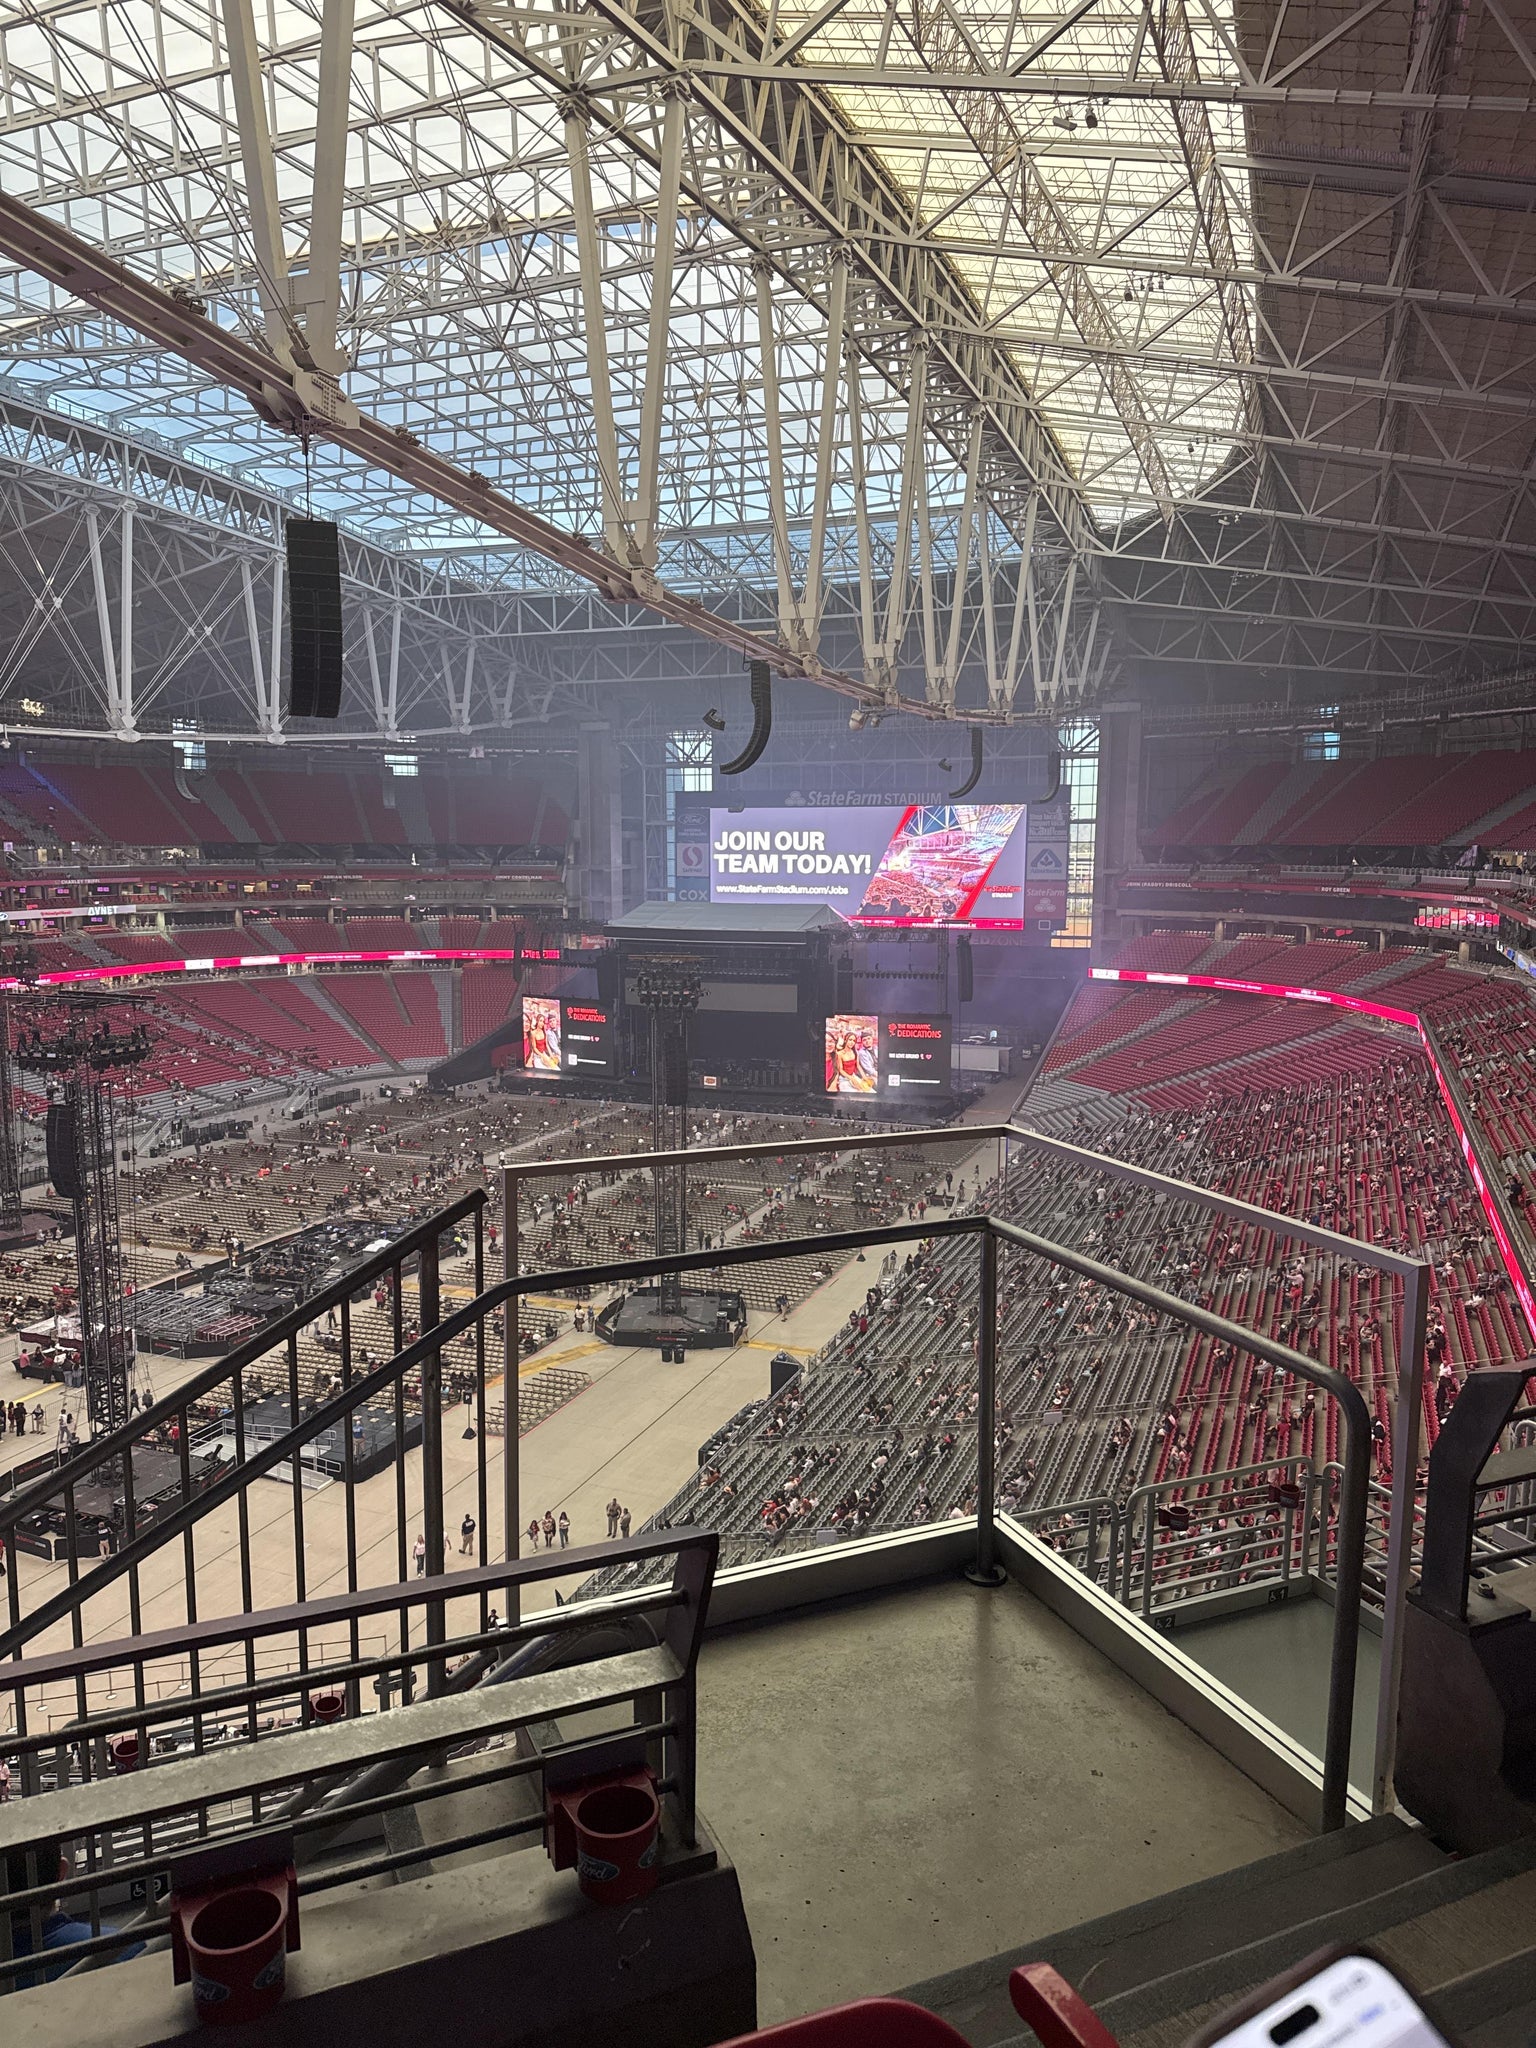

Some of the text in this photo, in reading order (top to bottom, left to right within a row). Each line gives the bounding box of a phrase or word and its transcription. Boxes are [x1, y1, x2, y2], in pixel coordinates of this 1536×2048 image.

[884, 792, 942, 805] STADIUM
[713, 831, 825, 851] JOIN OUR
[713, 854, 872, 874] TEAM TODAY!
[679, 889, 708, 901] COX
[716, 884, 849, 896] www.StateFarmStadium.com/Jobs
[966, 935, 1026, 946] EDZONE
[573, 1013, 606, 1023] DEDICATIONS
[897, 1029, 942, 1038] DEDICATIONS
[1280, 1588, 1285, 1600] 1
[1165, 1617, 1172, 1628] 2
